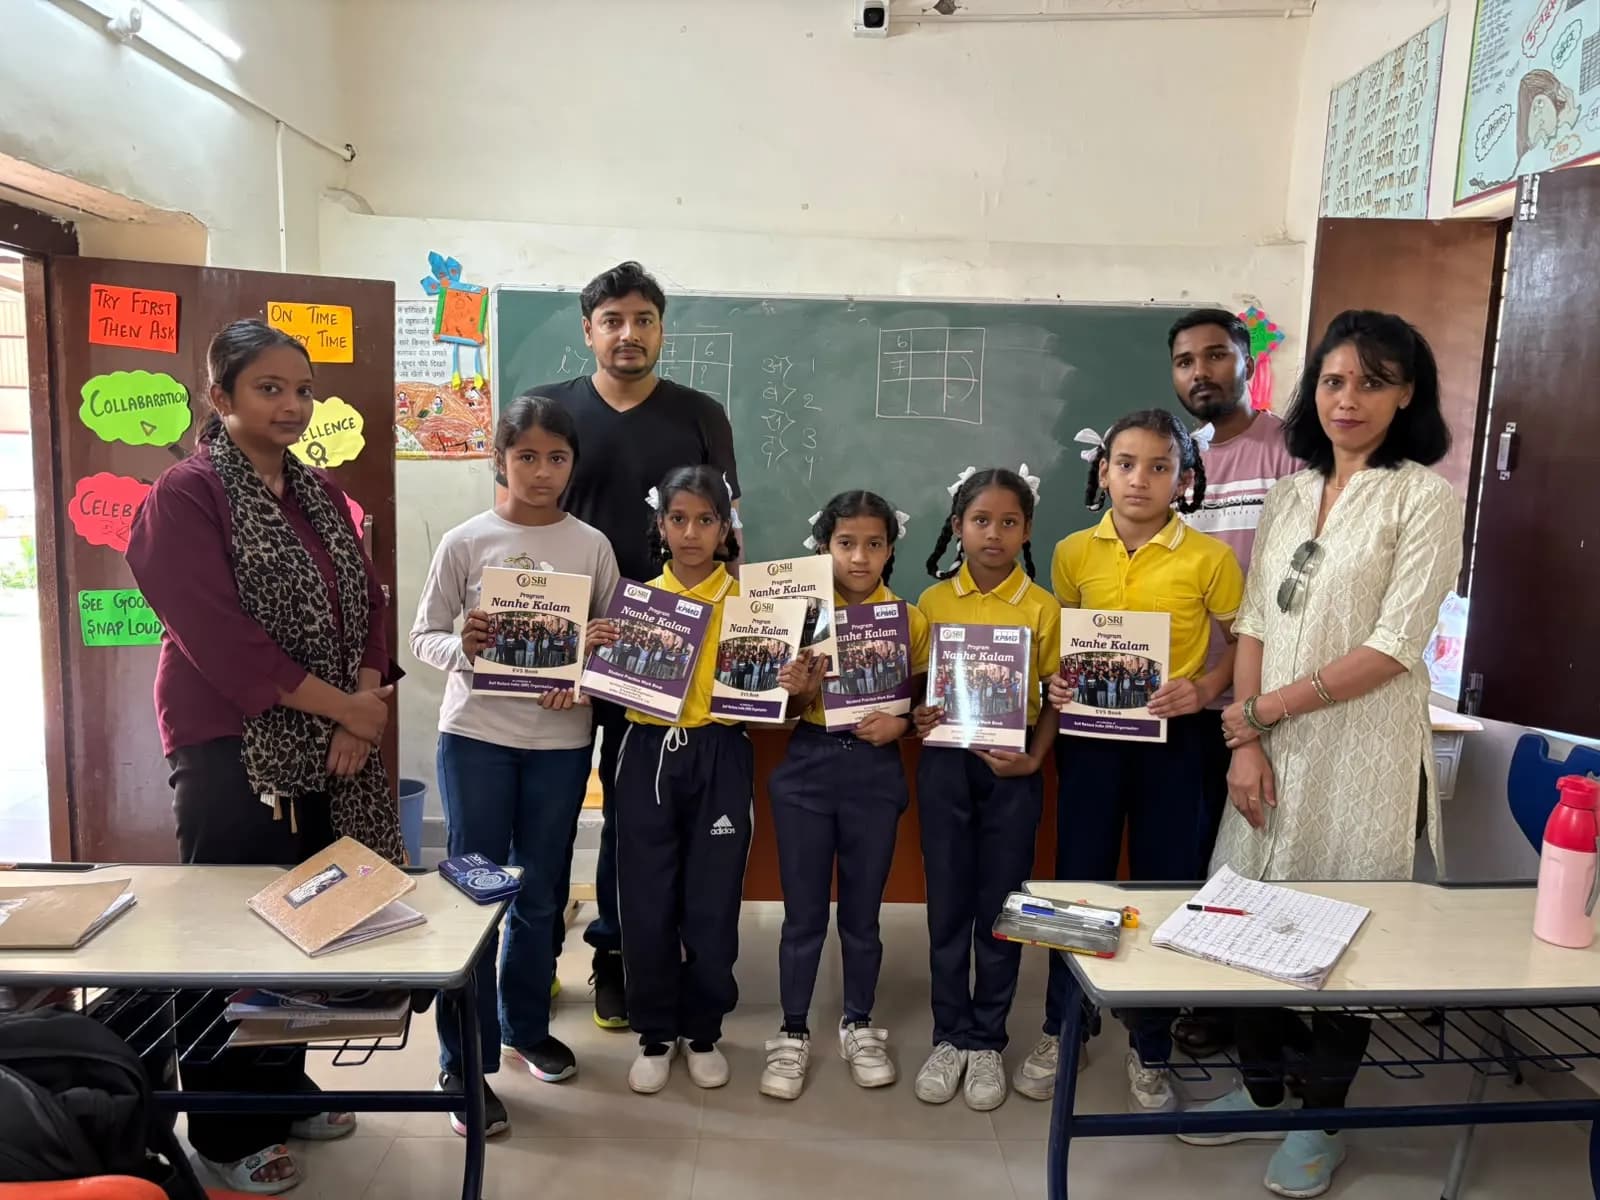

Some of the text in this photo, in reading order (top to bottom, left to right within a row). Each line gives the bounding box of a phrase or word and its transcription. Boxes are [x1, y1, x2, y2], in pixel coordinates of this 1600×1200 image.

[94, 289, 172, 320] TRY FIRST
[271, 305, 338, 325] ON TIME
[98, 317, 177, 341] THEN ASK
[318, 330, 348, 348] TIME
[90, 389, 188, 418] COLLABARATION
[301, 416, 357, 442] ELLENCE
[802, 426, 818, 449] 3
[779, 562, 793, 571] SRI
[531, 576, 546, 585] SRI
[771, 579, 792, 587] Program
[520, 592, 545, 601] Program
[749, 584, 816, 598] Nanhe Kalam
[82, 592, 104, 613] SEE
[492, 597, 571, 613] Nanhe Kalam
[620, 605, 692, 635] Nanhe Kalam
[851, 623, 874, 631] Program
[1107, 616, 1123, 625] SRI
[87, 618, 162, 640] SNAP LOUD
[729, 623, 789, 637] Nanhe Kalam
[864, 628, 897, 640] Kalam
[1070, 638, 1150, 651] Nanhe Kalam
[1097, 633, 1121, 643] Program
[967, 644, 990, 652] Program
[942, 650, 1015, 662] Nanhe Kalam
[710, 827, 736, 836] adidas
